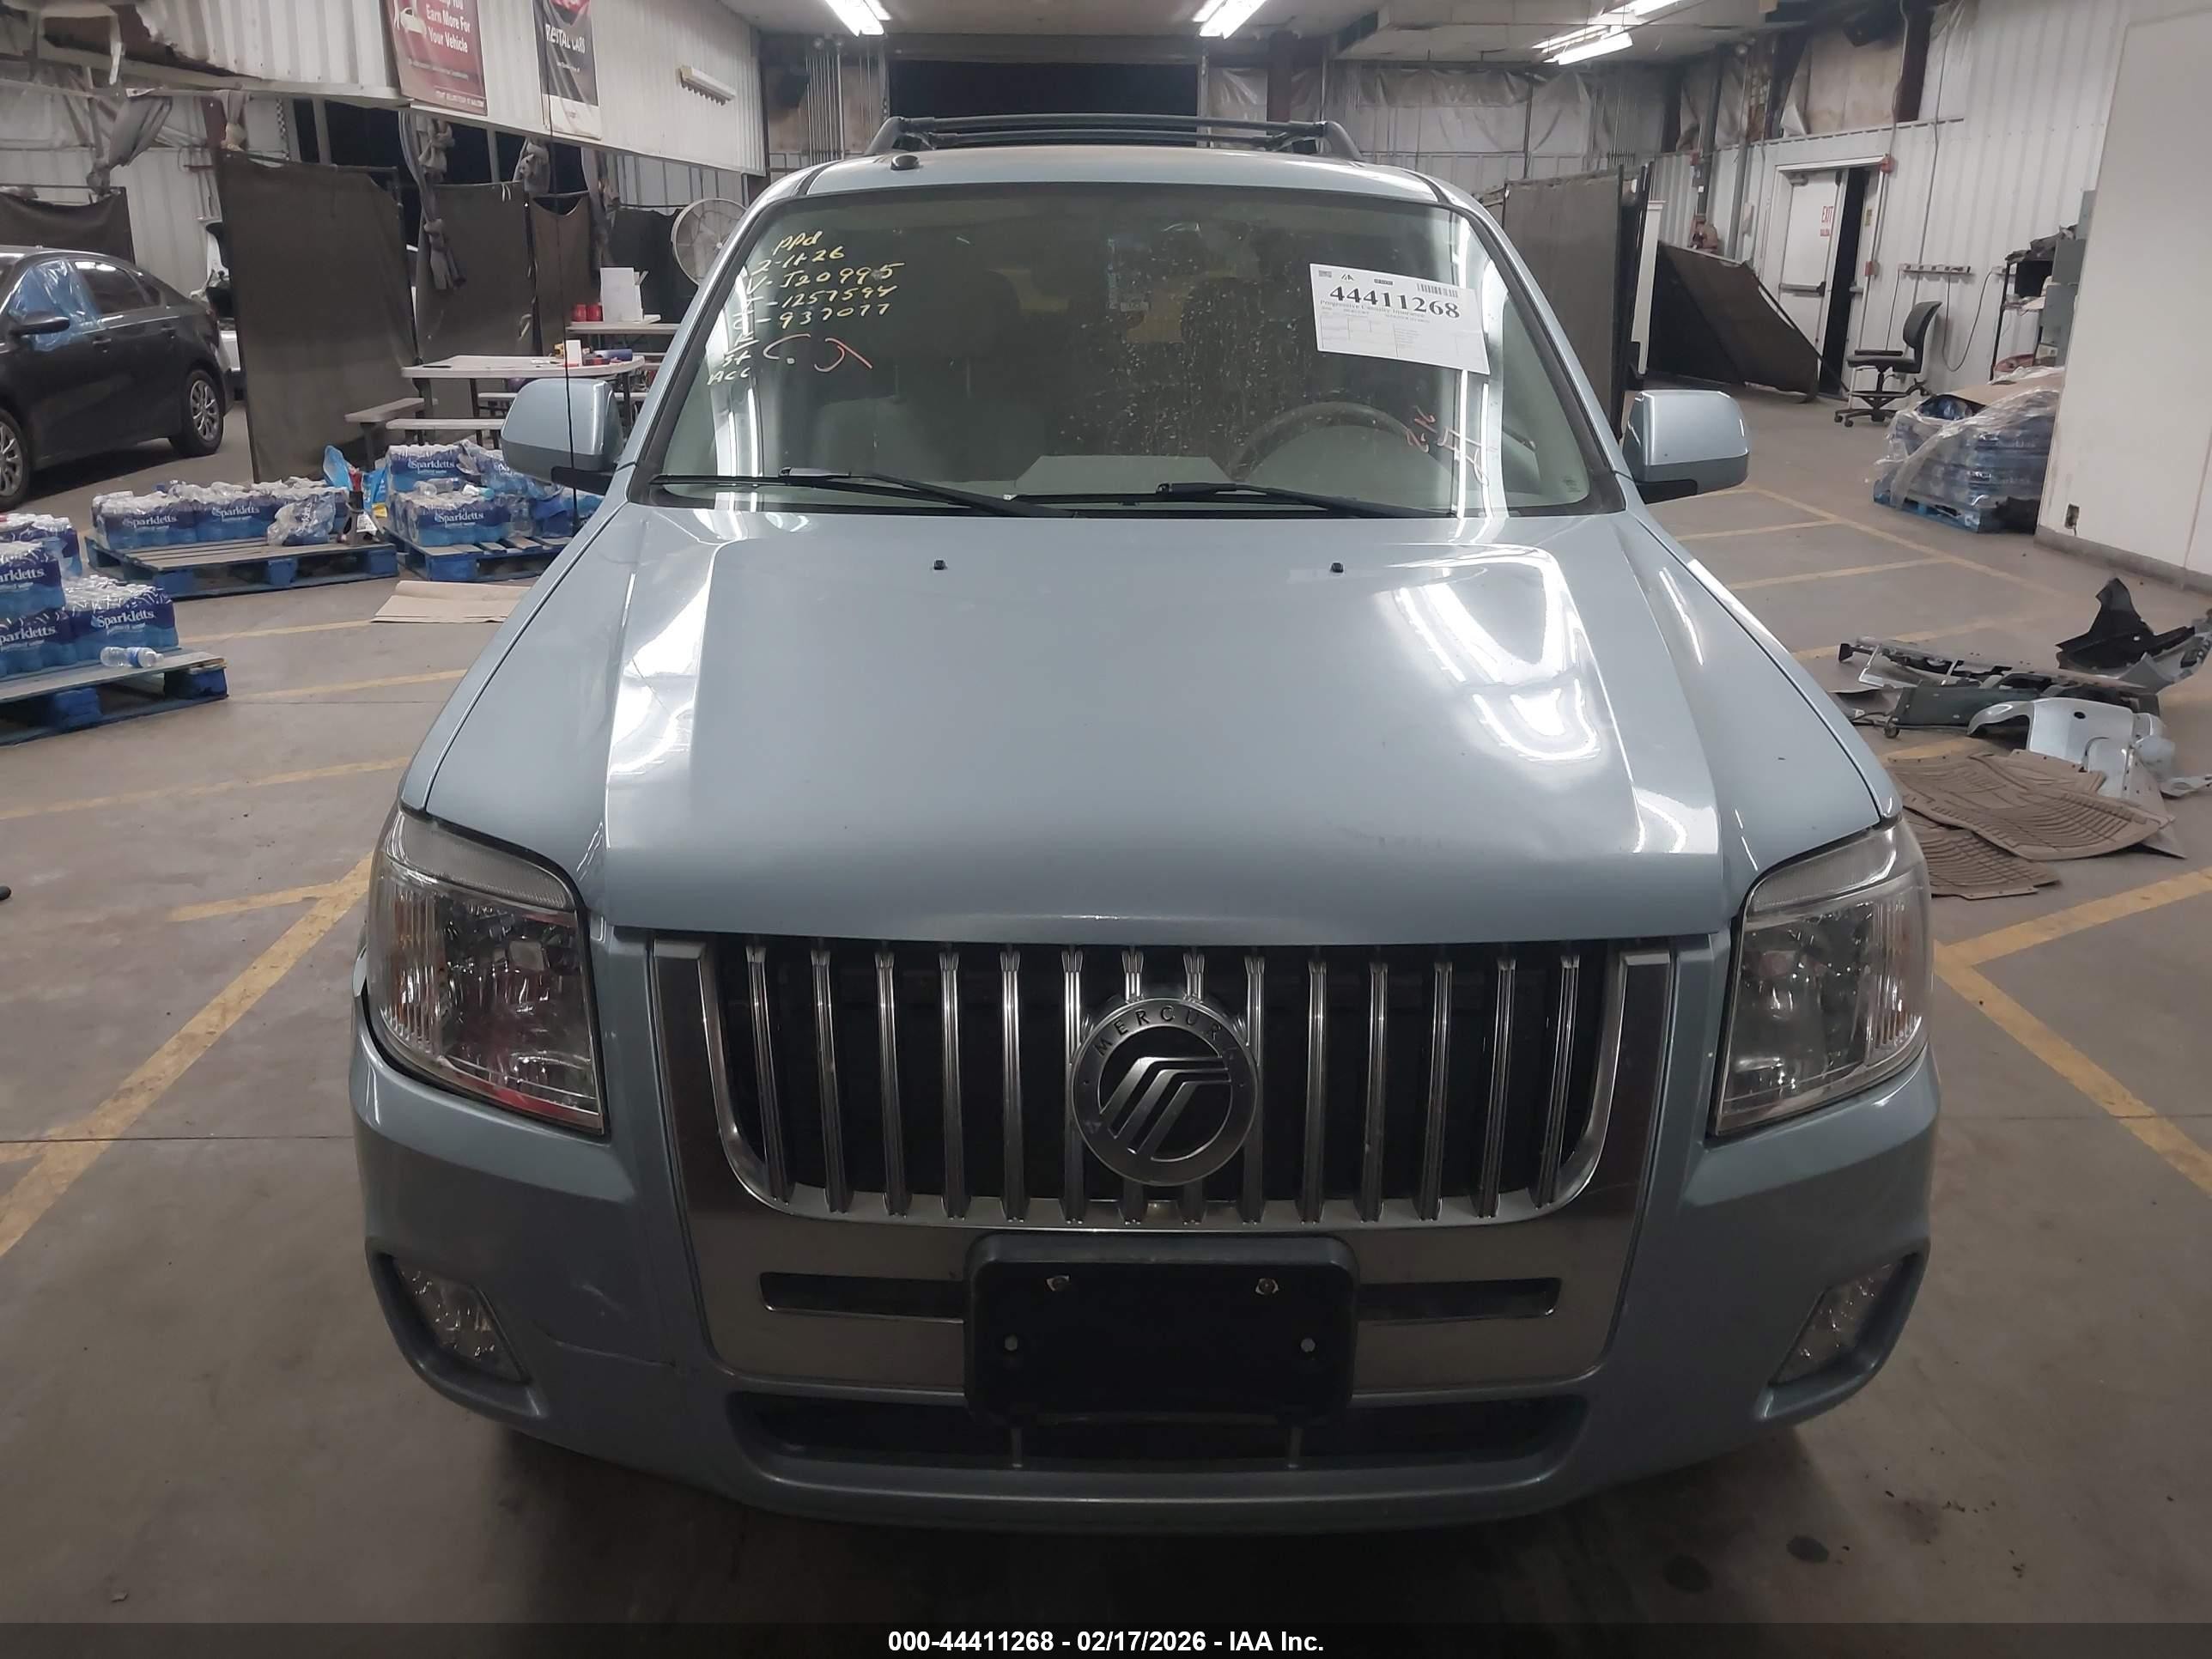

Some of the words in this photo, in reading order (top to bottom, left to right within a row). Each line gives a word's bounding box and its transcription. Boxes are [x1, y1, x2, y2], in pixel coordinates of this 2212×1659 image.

[426, 3, 442, 23] Earn
[442, 9, 459, 29] More
[460, 16, 471, 33] For
[428, 27, 444, 45] Your
[445, 32, 468, 53] Vehicle
[1329, 285, 1461, 319] 44411268
[96, 609, 155, 629] Sparkletts
